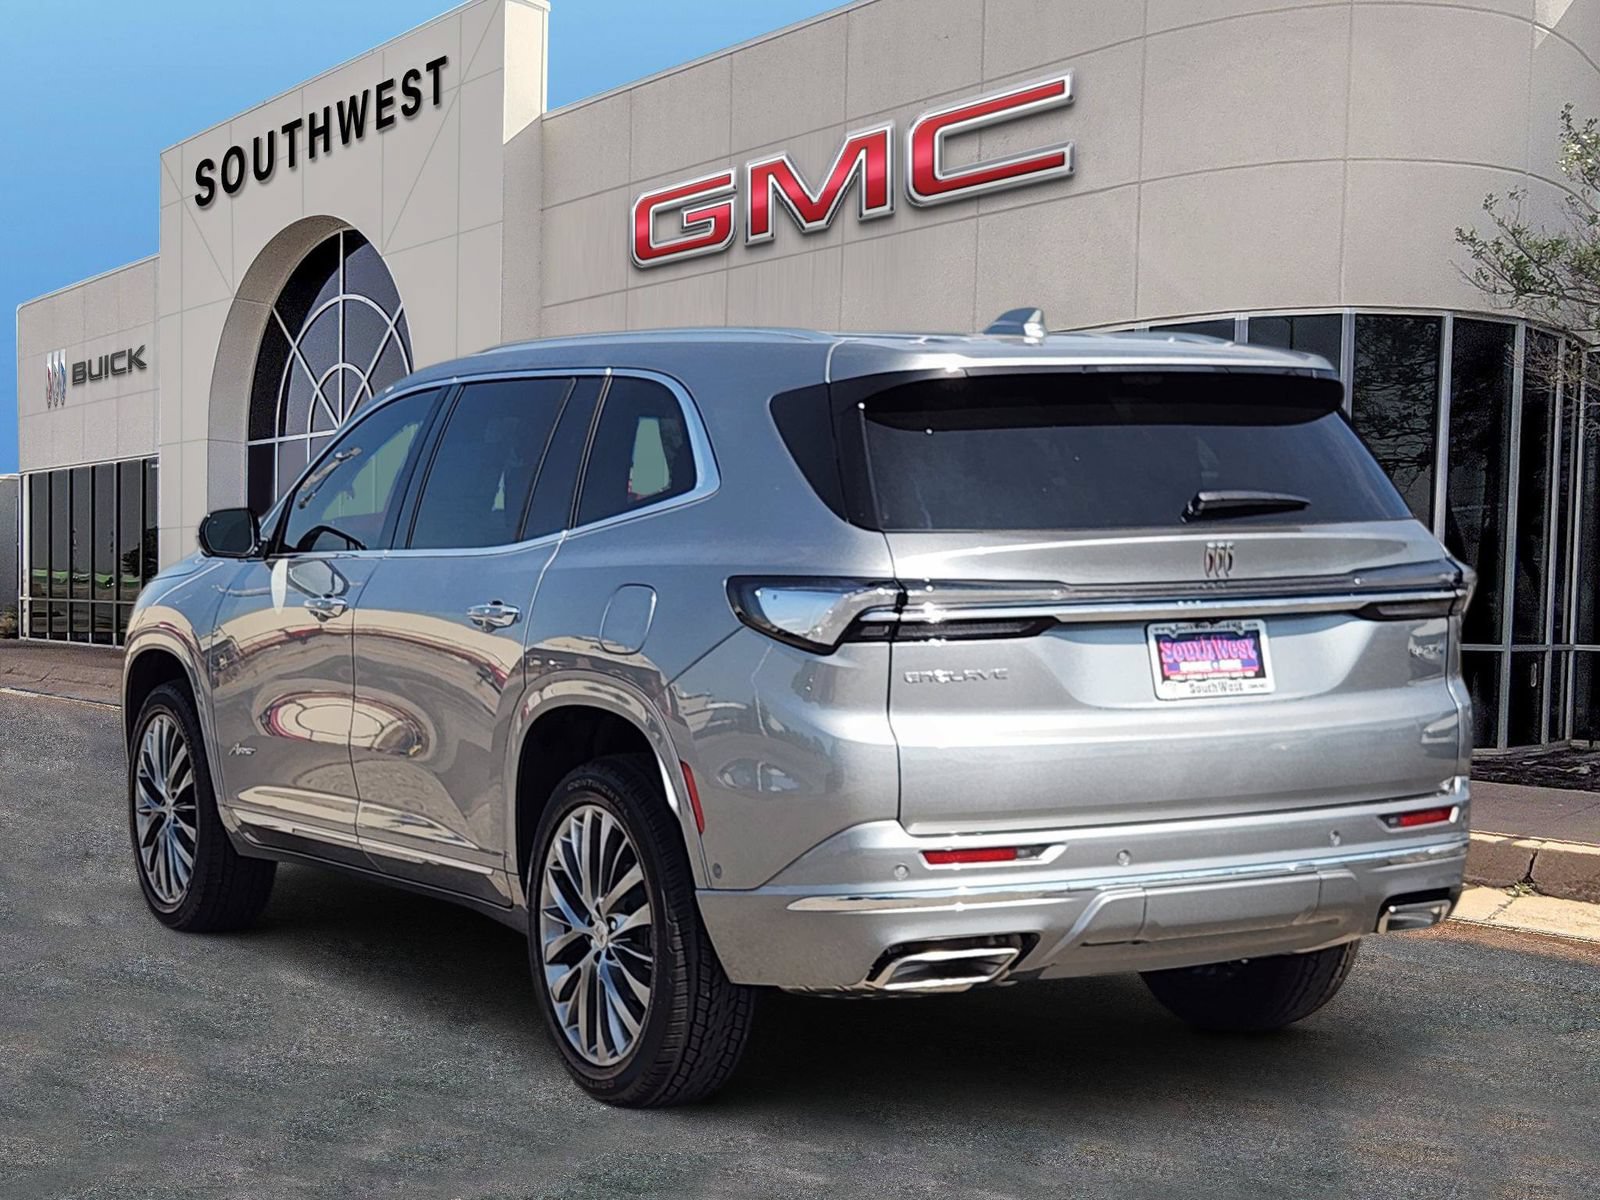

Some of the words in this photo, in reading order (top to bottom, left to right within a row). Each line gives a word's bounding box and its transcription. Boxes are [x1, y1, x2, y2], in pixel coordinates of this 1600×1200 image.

[194, 55, 448, 207] SOUTHWEST
[630, 68, 1075, 269] GMC
[72, 344, 147, 386] BUICK
